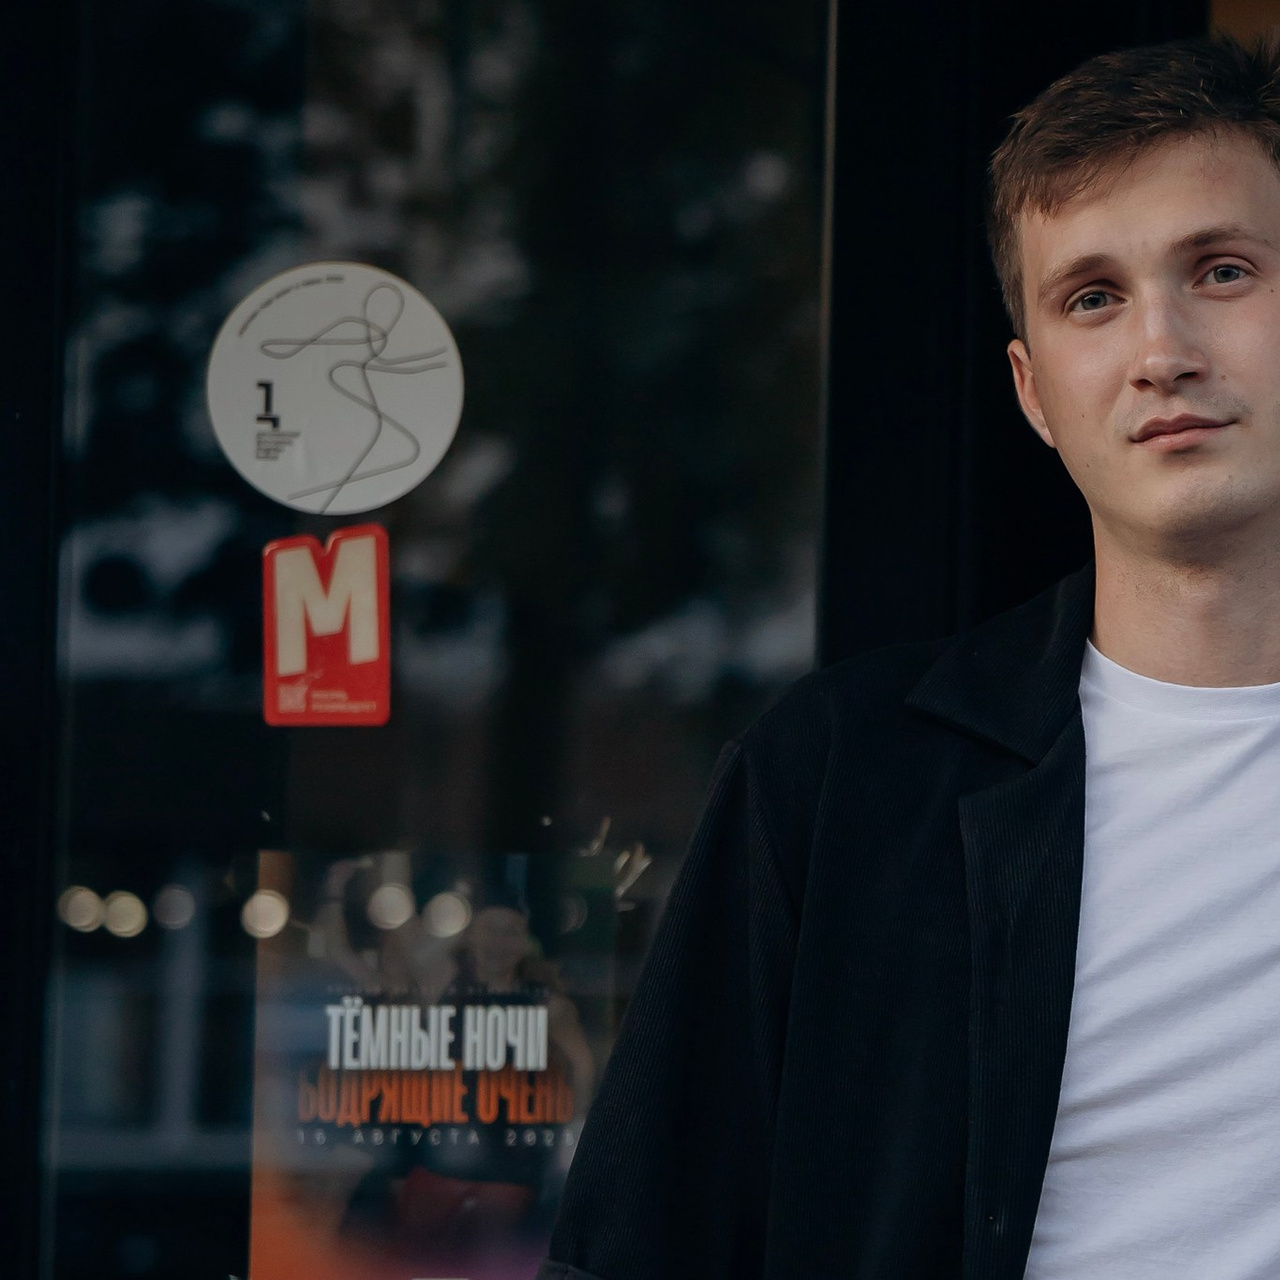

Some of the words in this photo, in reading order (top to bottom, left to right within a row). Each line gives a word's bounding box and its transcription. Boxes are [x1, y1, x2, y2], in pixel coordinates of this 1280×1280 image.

[325, 995, 457, 1071] ТЁМНЫЕ
[463, 1004, 549, 1072] НОЧИ
[352, 1127, 480, 1146] АВГУСТА
